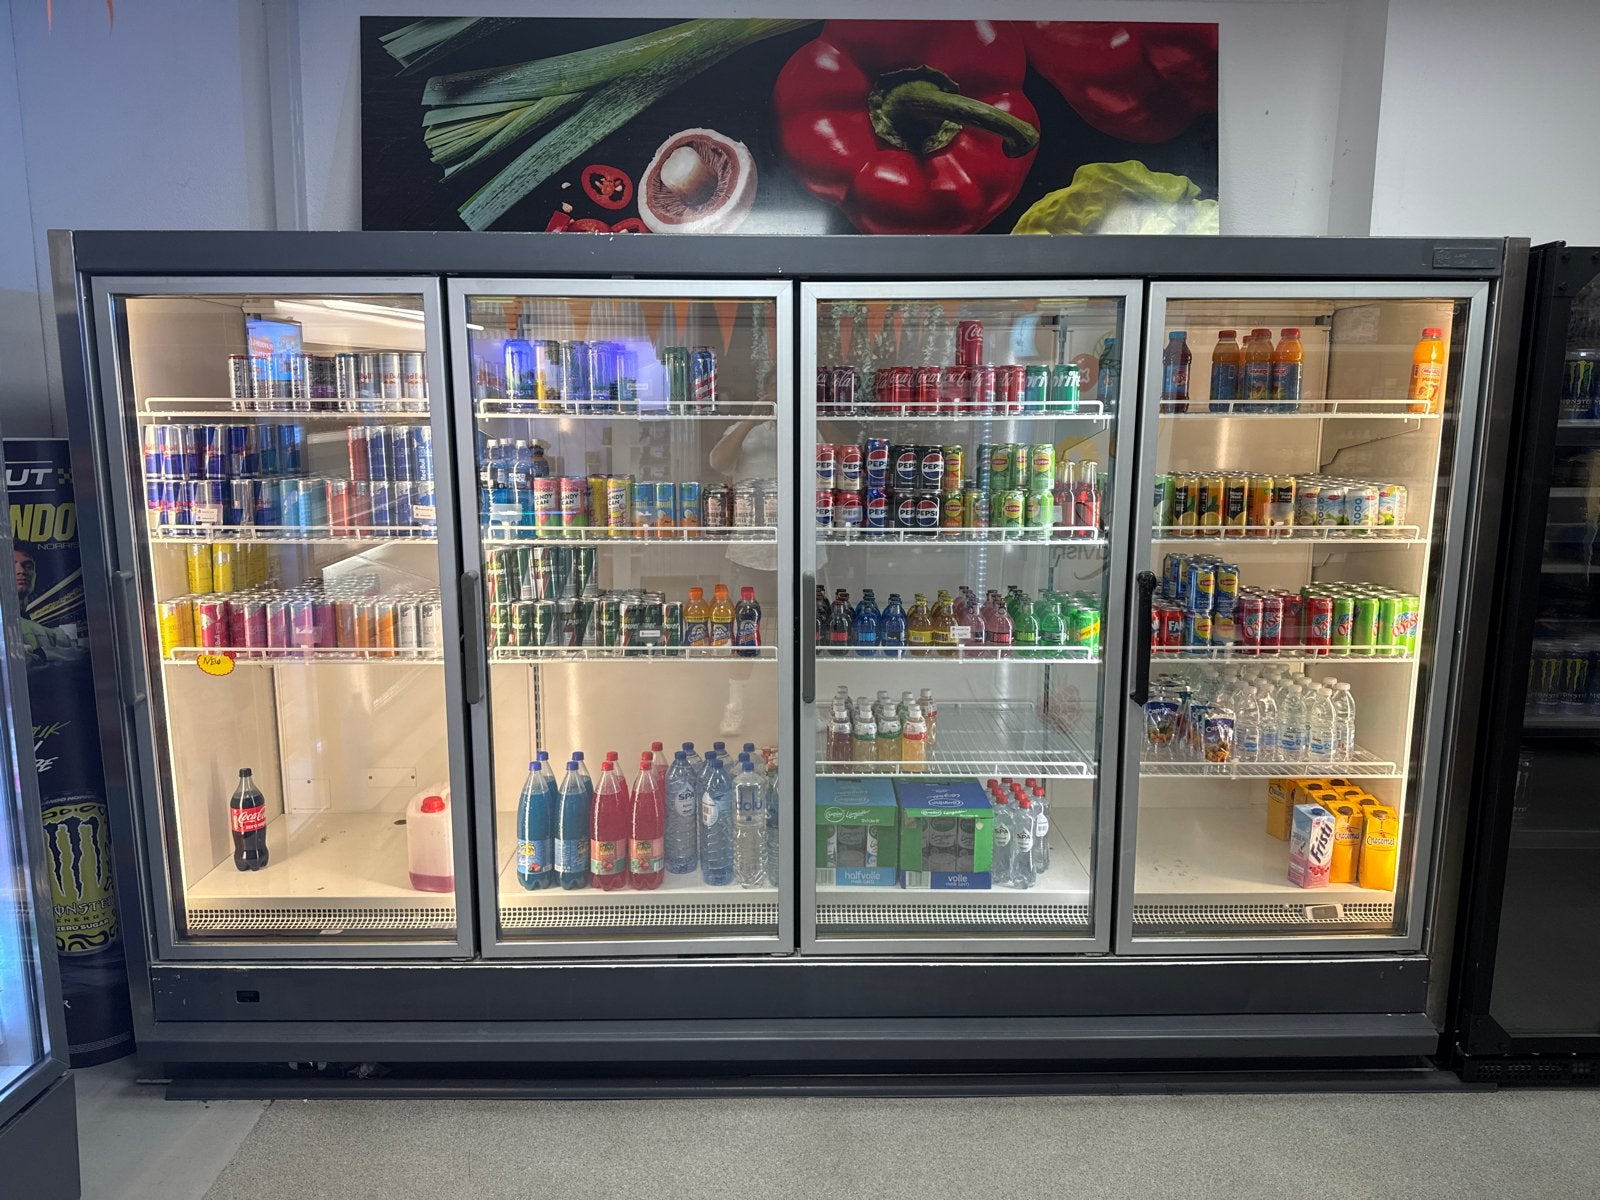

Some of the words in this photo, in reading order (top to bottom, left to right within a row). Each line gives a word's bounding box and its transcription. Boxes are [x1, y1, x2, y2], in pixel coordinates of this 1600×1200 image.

[7, 469, 52, 485] UT
[10, 503, 76, 542] NDO
[1311, 823, 1333, 864] Fristi
[1367, 835, 1395, 847] Chocomel
[844, 871, 881, 880] halfvolle
[948, 874, 968, 882] volle
[54, 897, 113, 916] ONSTE
[57, 912, 106, 922] ENERGY
